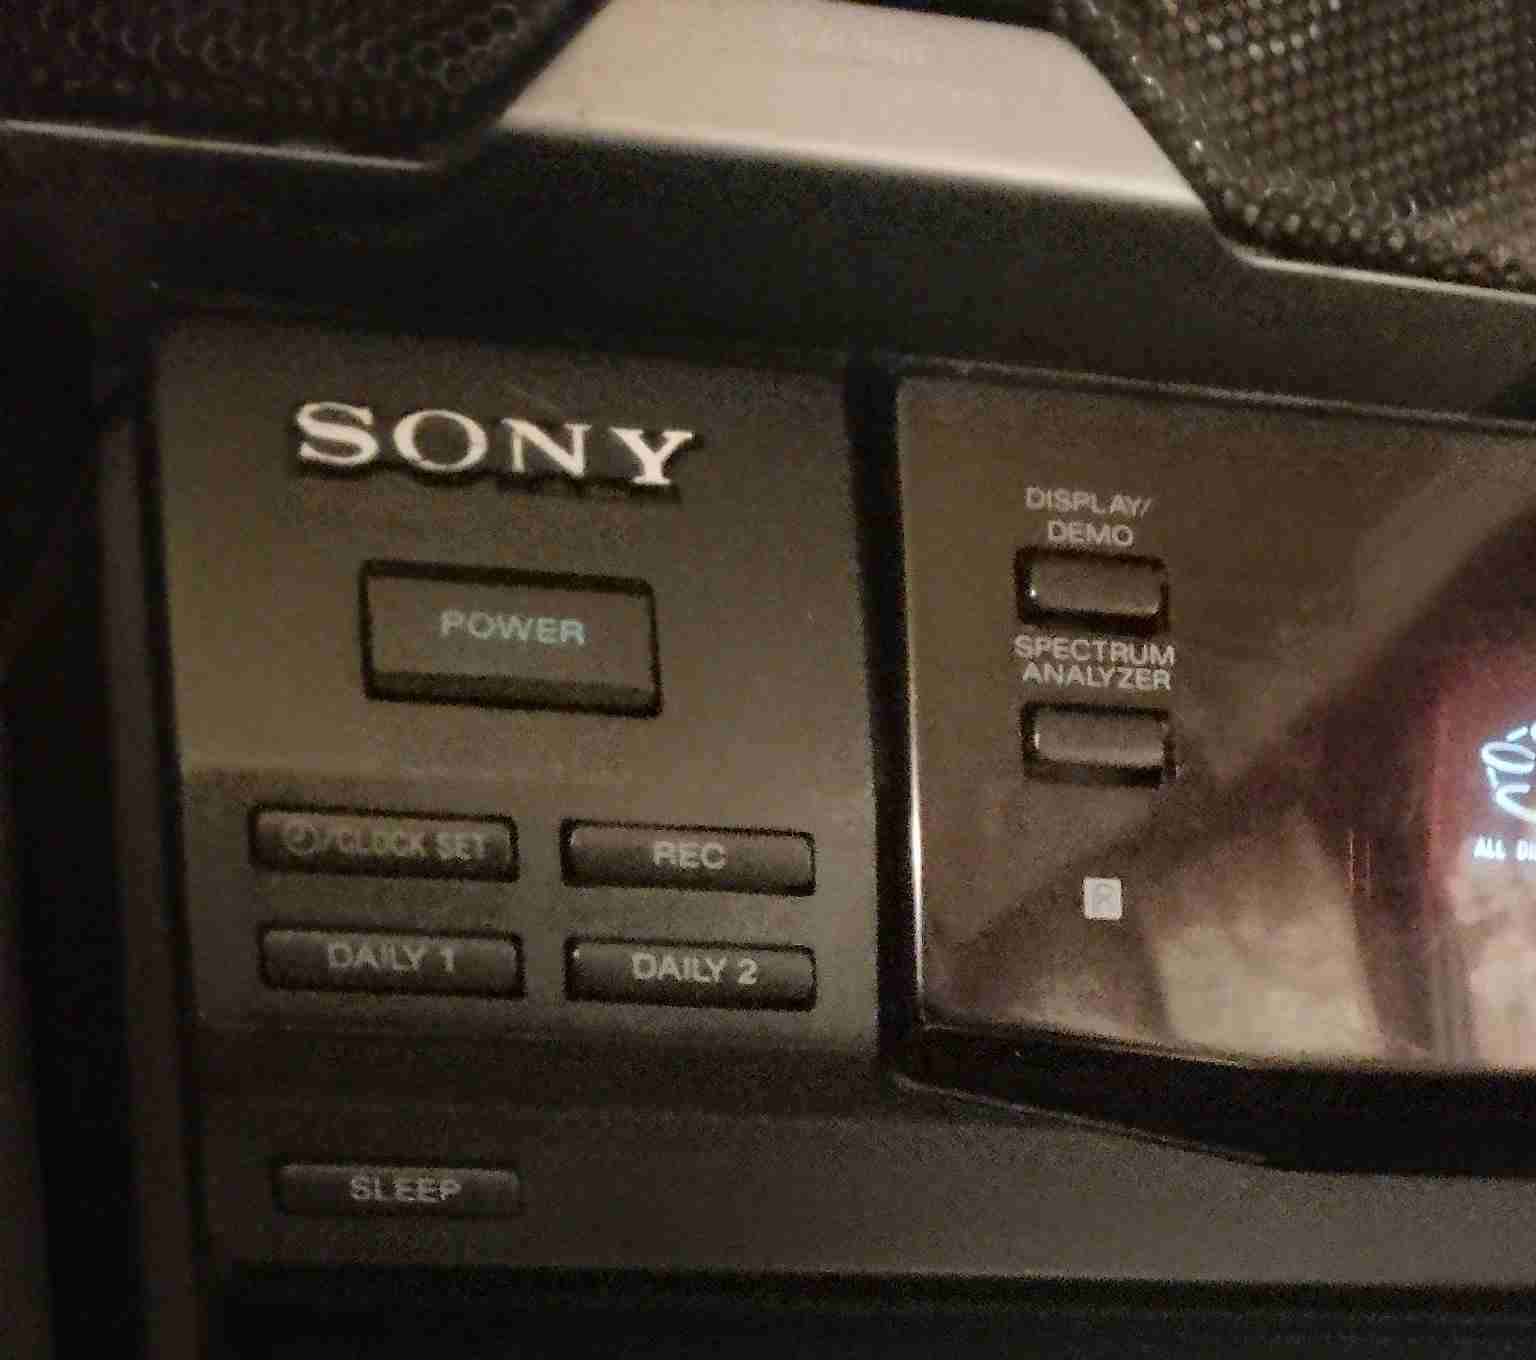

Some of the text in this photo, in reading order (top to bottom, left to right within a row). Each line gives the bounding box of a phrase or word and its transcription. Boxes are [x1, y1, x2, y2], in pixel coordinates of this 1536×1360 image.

[295, 402, 693, 486] SONY
[1026, 486, 1152, 518] DISPLAY/
[1048, 520, 1134, 548] DEMO
[440, 610, 586, 646] POWER
[1014, 635, 1175, 668] SPECTRUM
[1022, 662, 1173, 692] ANALYZER
[437, 832, 487, 862] SET
[653, 842, 727, 870] REC
[328, 942, 457, 974] DAILY 1
[632, 953, 759, 984] DAILY 2
[350, 1176, 462, 1202] SLEEP
